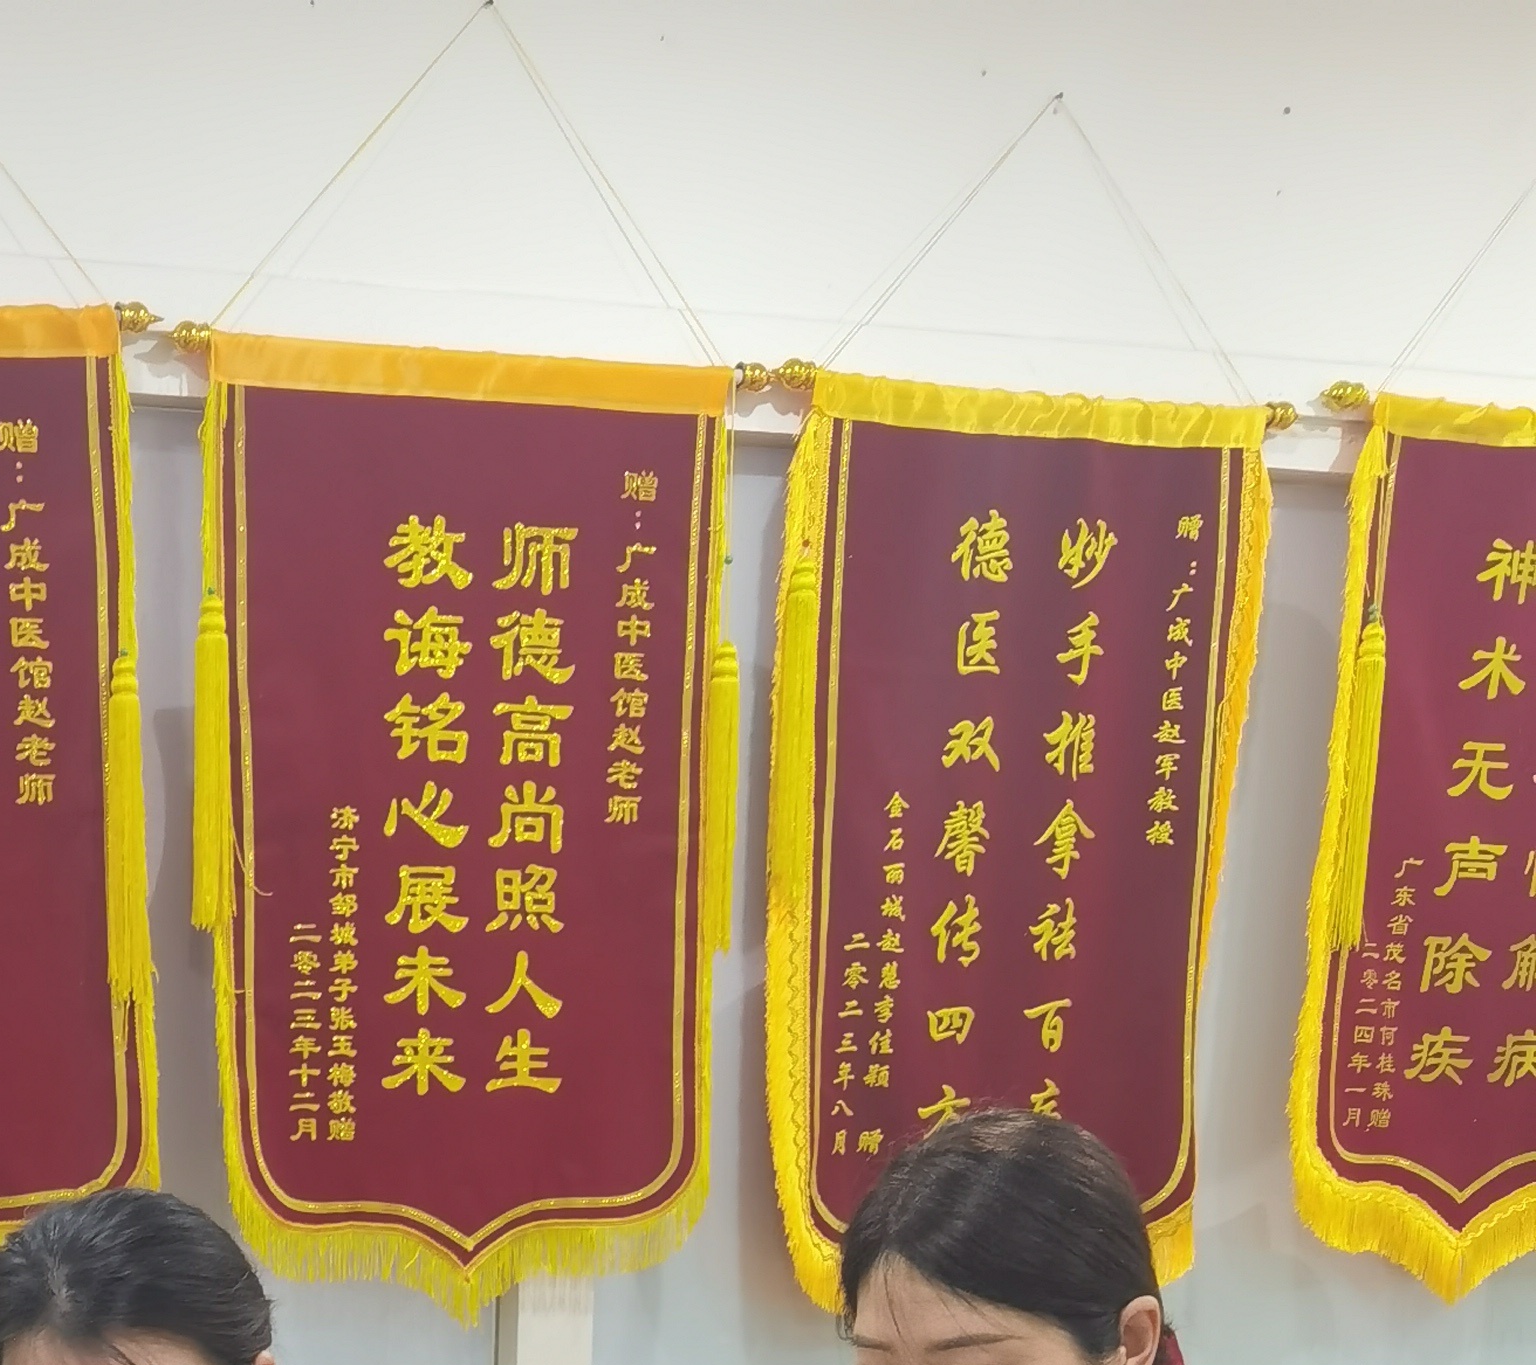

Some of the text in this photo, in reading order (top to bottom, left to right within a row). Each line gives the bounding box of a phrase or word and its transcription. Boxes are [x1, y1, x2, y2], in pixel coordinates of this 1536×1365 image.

[381, 513, 475, 1096] 教诲铭心展未来
[484, 521, 579, 1094] 师德高尚照人生
[1403, 537, 1536, 1086] 神术无声除疾
[288, 923, 323, 1142] 二零二三年十二月
[326, 805, 360, 1141] 济宁市邹城弟子张玉梅敬赠
[830, 932, 871, 1156] 二零二三年八月
[1342, 942, 1380, 1128] 二零二四年一月
[1366, 857, 1425, 1128] 广东省茂名市何桂珠赠
